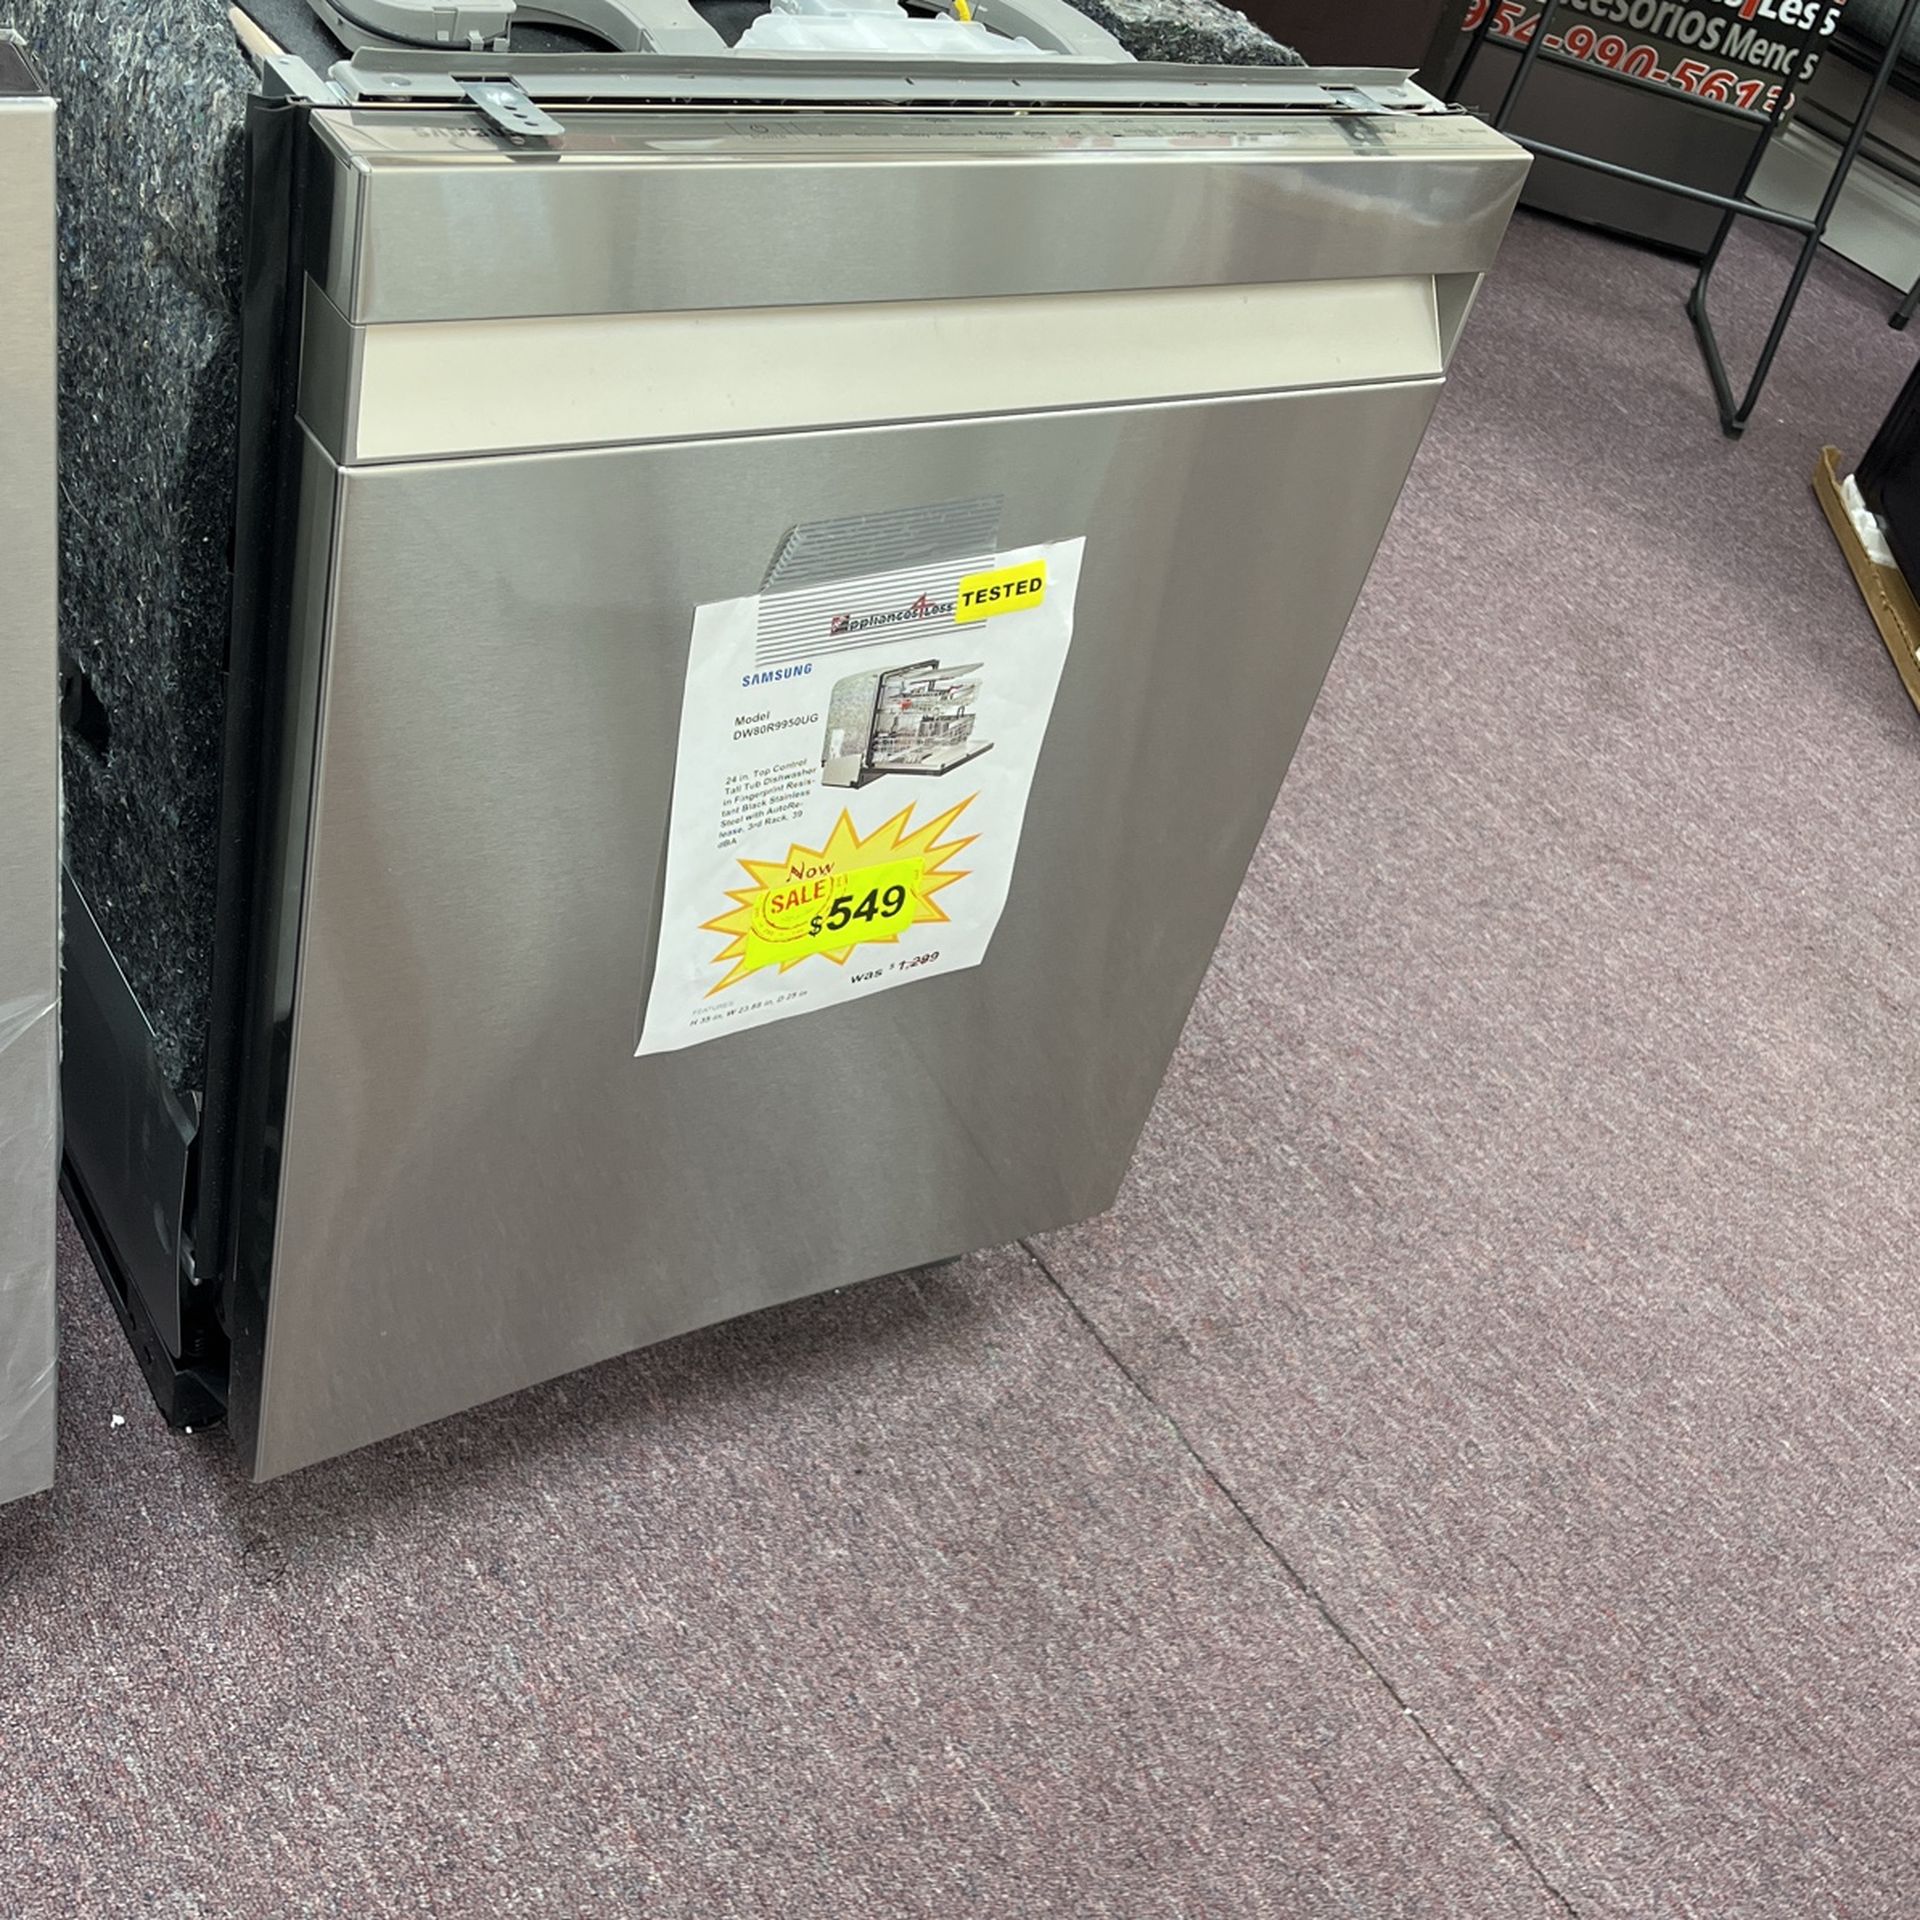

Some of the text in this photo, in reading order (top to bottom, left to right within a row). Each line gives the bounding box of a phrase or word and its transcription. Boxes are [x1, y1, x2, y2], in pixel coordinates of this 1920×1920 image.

[961, 577, 1043, 607] TESTED
[742, 662, 813, 688] SAMSUNG
[734, 711, 771, 727] Model
[724, 767, 817, 796] Tall Tub Dishwasher
[725, 776, 738, 786] 24
[753, 769, 772, 779] Top
[772, 758, 808, 773] Control
[720, 789, 811, 818] tant Black Stainless
[722, 798, 733, 807] in
[733, 785, 785, 804] Fingerprint
[720, 815, 744, 828] Steel
[744, 809, 765, 821] with
[747, 820, 763, 831] 3rd
[786, 861, 835, 883] Now
[770, 878, 828, 915] SALE
[808, 884, 907, 937] $549
[850, 968, 883, 984] was
